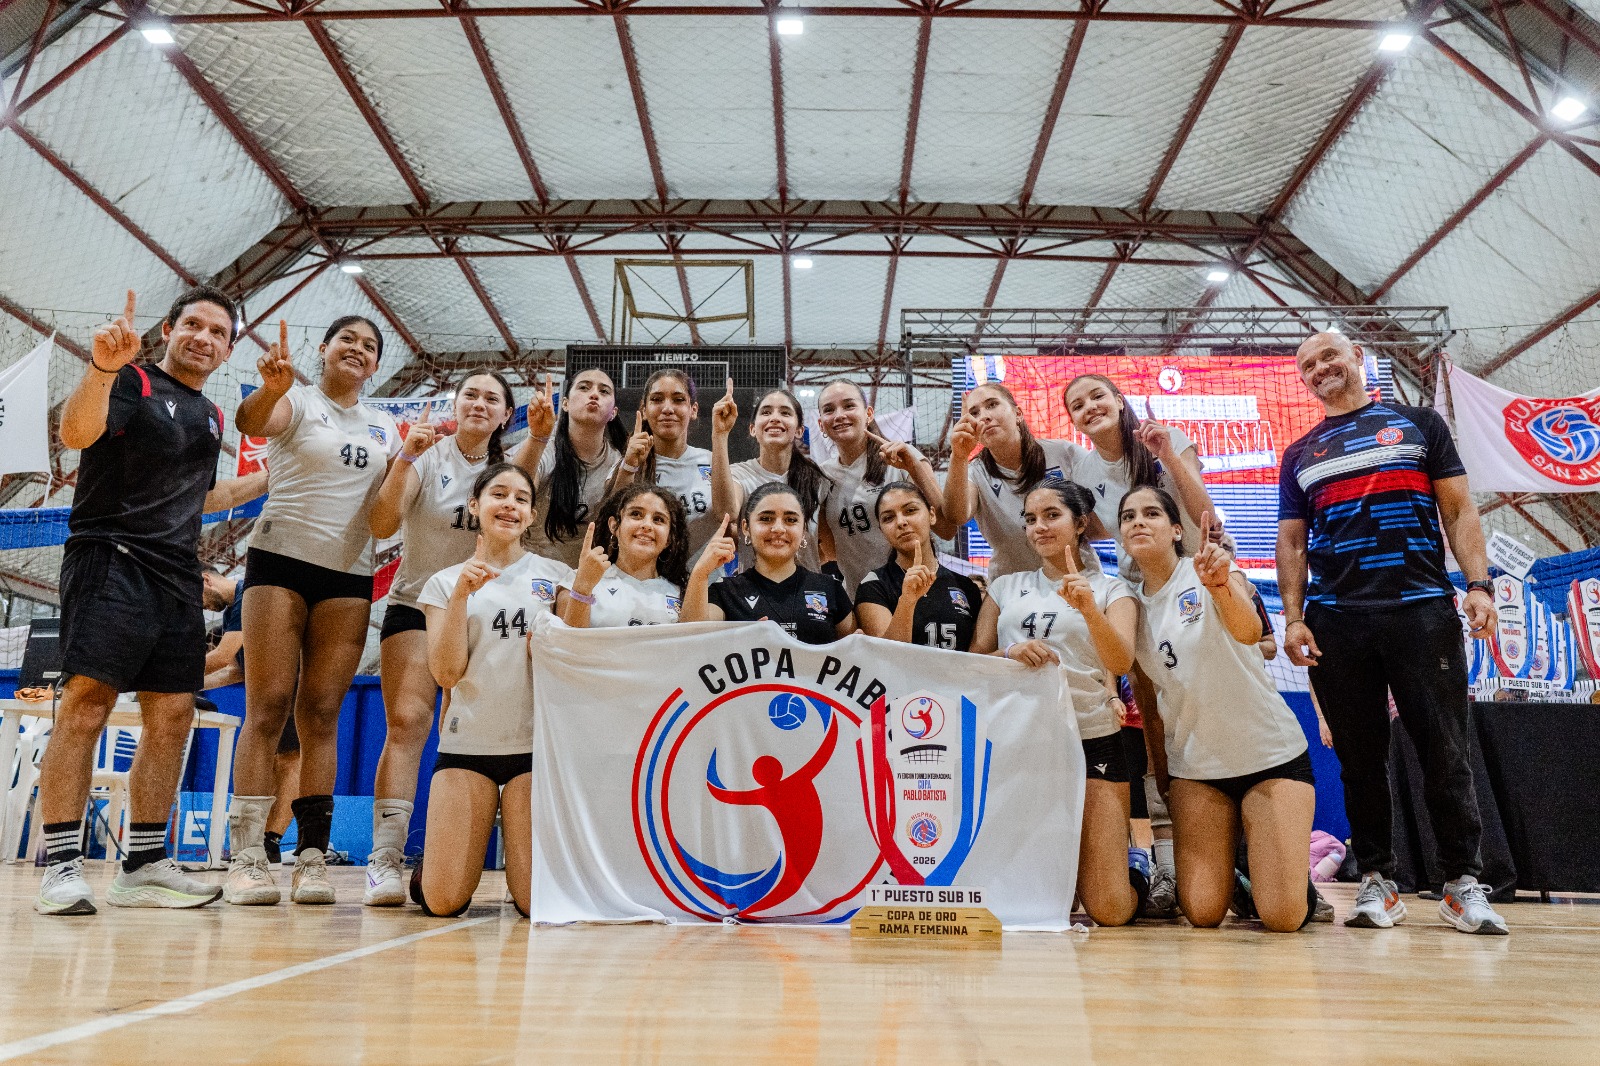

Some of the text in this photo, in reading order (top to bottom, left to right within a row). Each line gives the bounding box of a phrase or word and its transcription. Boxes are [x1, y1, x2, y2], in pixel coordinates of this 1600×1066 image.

[653, 353, 699, 361] TIEMPO
[340, 443, 369, 470] 48
[1532, 455, 1570, 479] SAN
[839, 503, 871, 536] 49
[492, 608, 528, 639] 44
[1021, 611, 1058, 639] 47
[924, 622, 957, 650] 15
[1158, 639, 1178, 670] 3
[698, 648, 887, 711] COPA PAB
[1508, 680, 1530, 688] PUESTO
[918, 780, 932, 789] COPA
[904, 790, 947, 801] PABLO BATISTA
[911, 812, 937, 820] HISPANO
[913, 856, 936, 865] 2026
[884, 890, 934, 903] PUESTO
[938, 891, 964, 903] SUB
[968, 891, 982, 904] 16
[887, 911, 957, 922] COPA DE ORO
[879, 923, 968, 935] RAMA FEMENINA
